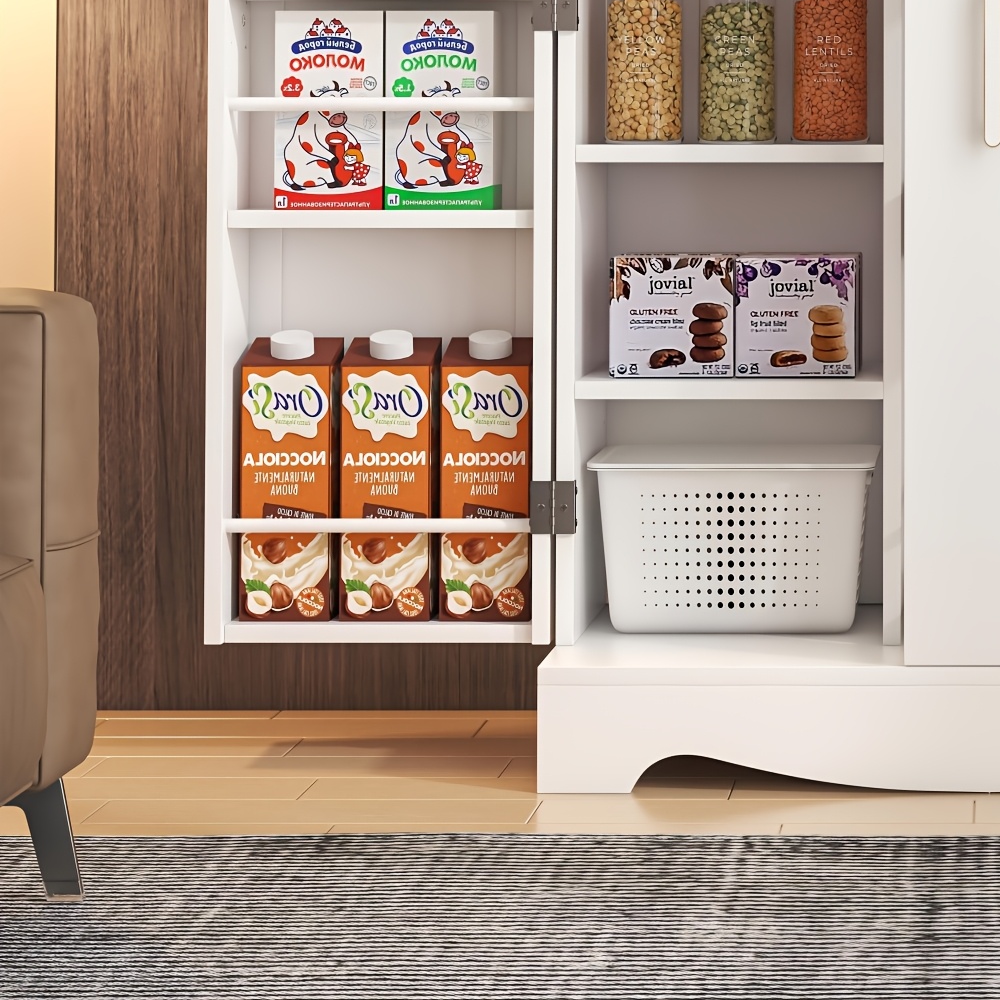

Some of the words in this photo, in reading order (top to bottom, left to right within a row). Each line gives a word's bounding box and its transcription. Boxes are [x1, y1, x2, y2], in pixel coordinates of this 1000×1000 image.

[817, 35, 842, 44] RED
[626, 47, 657, 56] PEAS
[719, 47, 751, 56] PEAS
[805, 47, 853, 56] LENTILS
[648, 275, 693, 295] jovial
[768, 278, 814, 298] jovial
